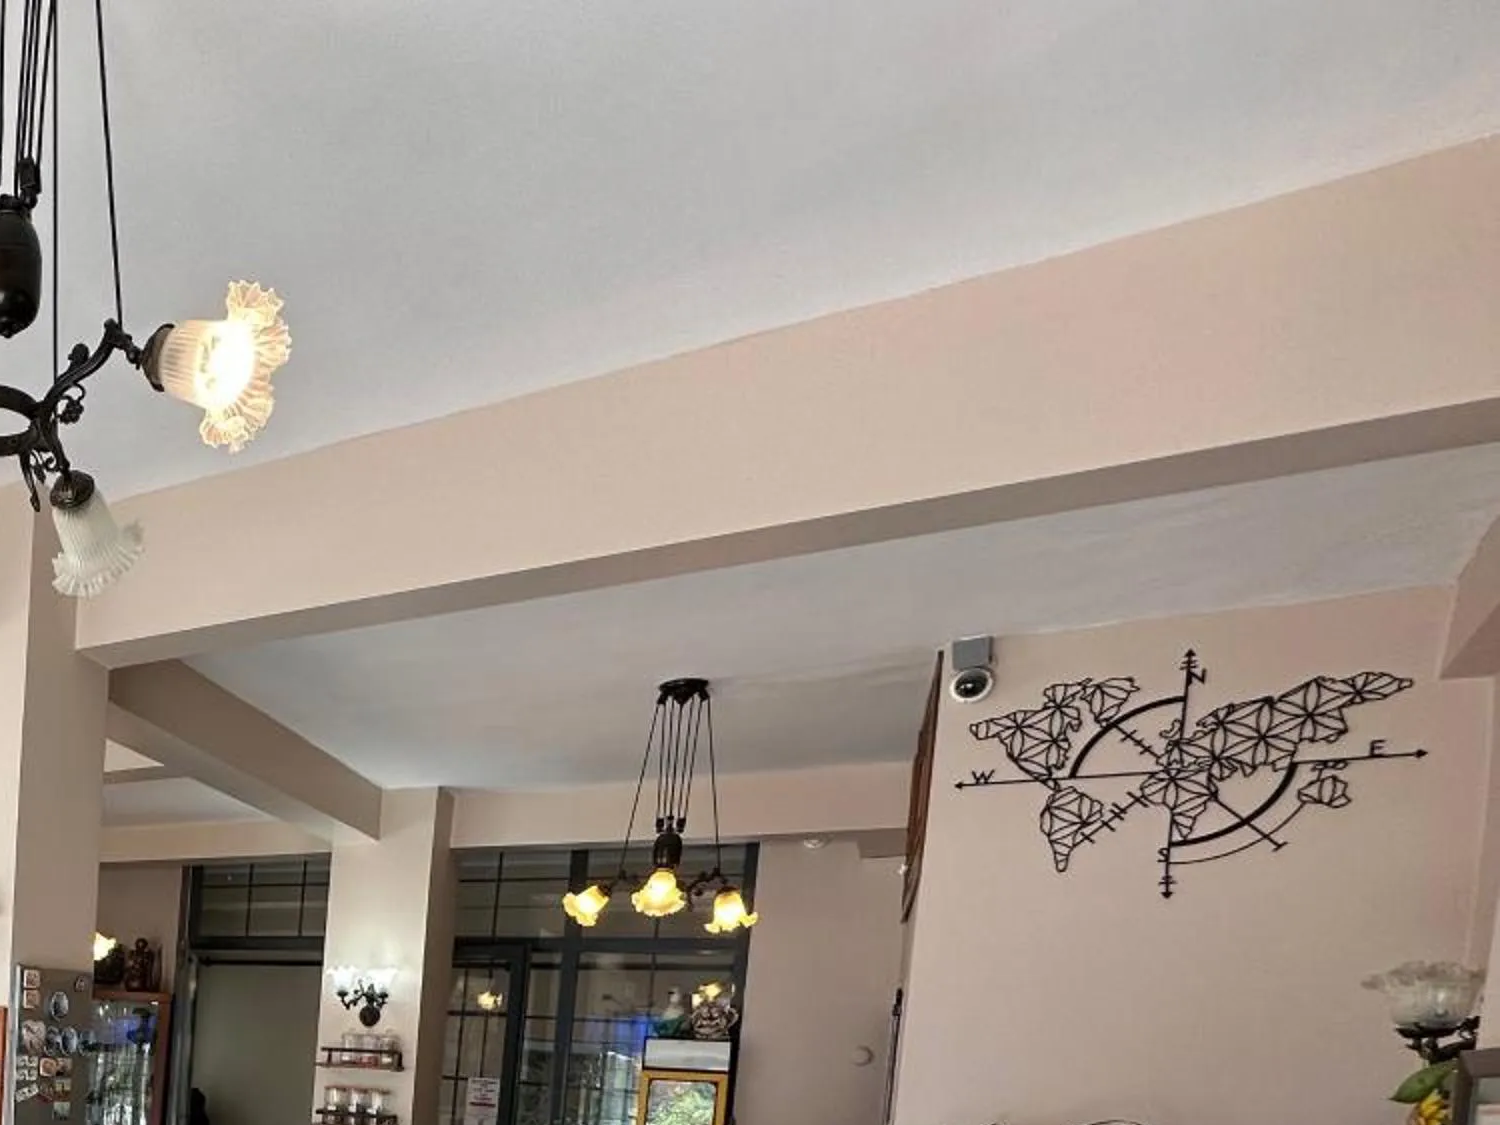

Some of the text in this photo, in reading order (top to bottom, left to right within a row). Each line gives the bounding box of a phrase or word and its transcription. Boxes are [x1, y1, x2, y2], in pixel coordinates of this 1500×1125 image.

[1187, 668, 1206, 685] N
[1369, 739, 1387, 759] E
[971, 769, 995, 785] W
[1157, 848, 1170, 863] S
